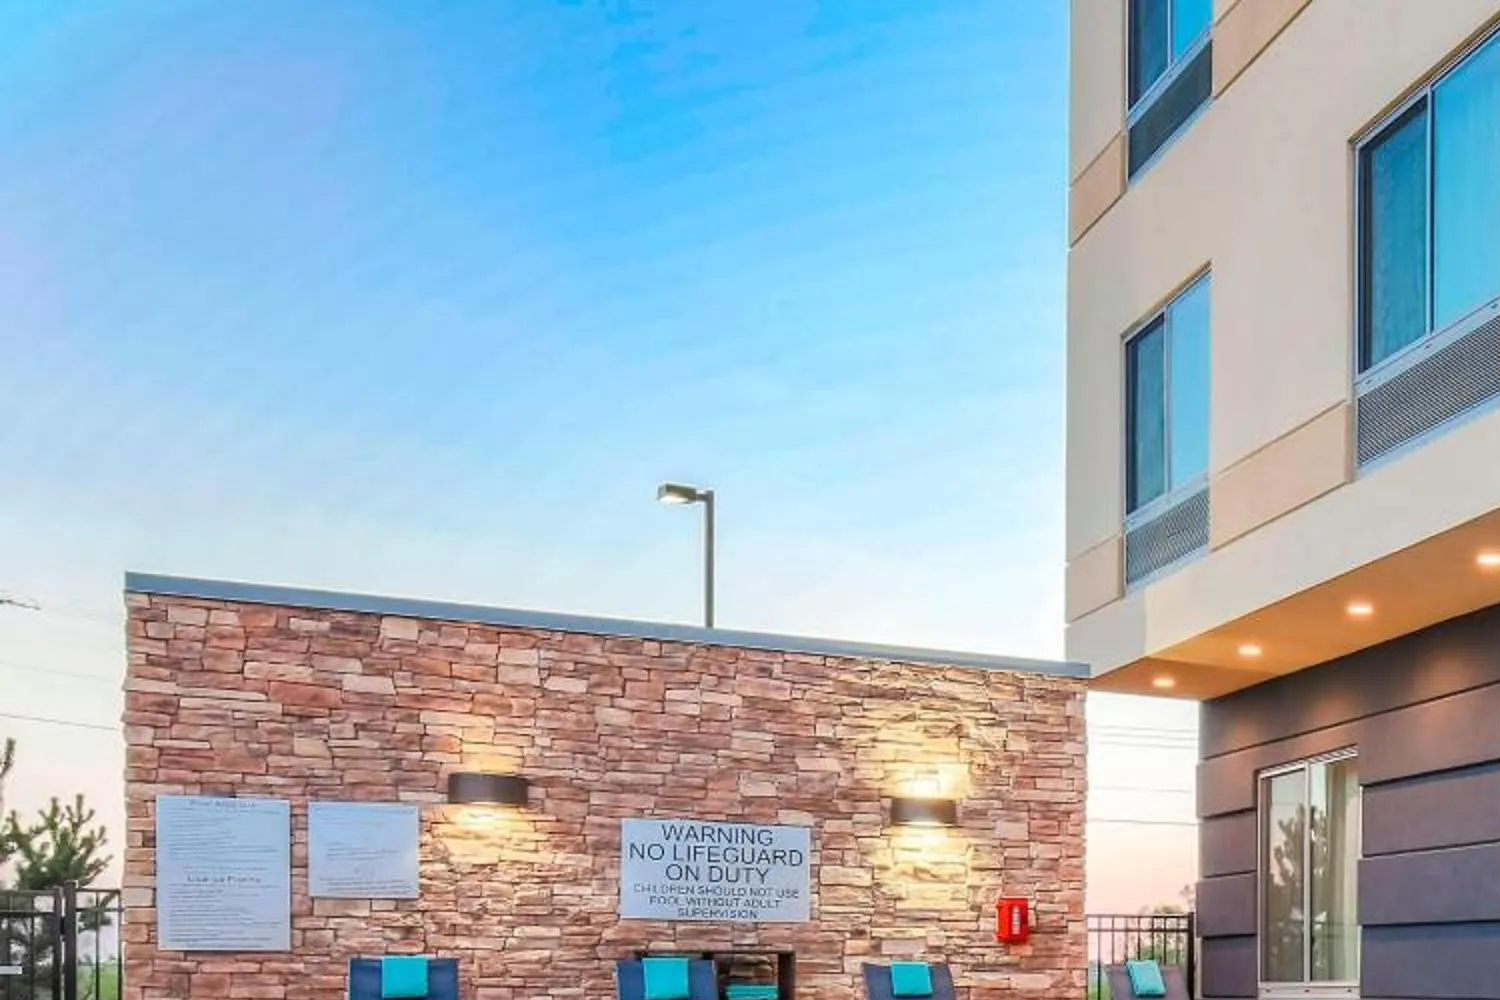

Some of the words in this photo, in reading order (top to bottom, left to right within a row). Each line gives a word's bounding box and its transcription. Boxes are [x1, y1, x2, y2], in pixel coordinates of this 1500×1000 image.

[661, 824, 773, 846] WARNING
[629, 843, 665, 861] NO
[673, 846, 803, 867] LIFEGUARD
[665, 864, 699, 881] ON
[708, 865, 770, 884] DUTY
[634, 883, 695, 895] CHILDREN
[697, 885, 746, 897] SHOULD
[750, 887, 774, 898] NOT
[777, 888, 799, 899] USE
[649, 895, 681, 906] POOL
[686, 897, 740, 908] WITHOUT
[744, 899, 782, 909] ADULT
[678, 908, 758, 919] SUPERVISION
